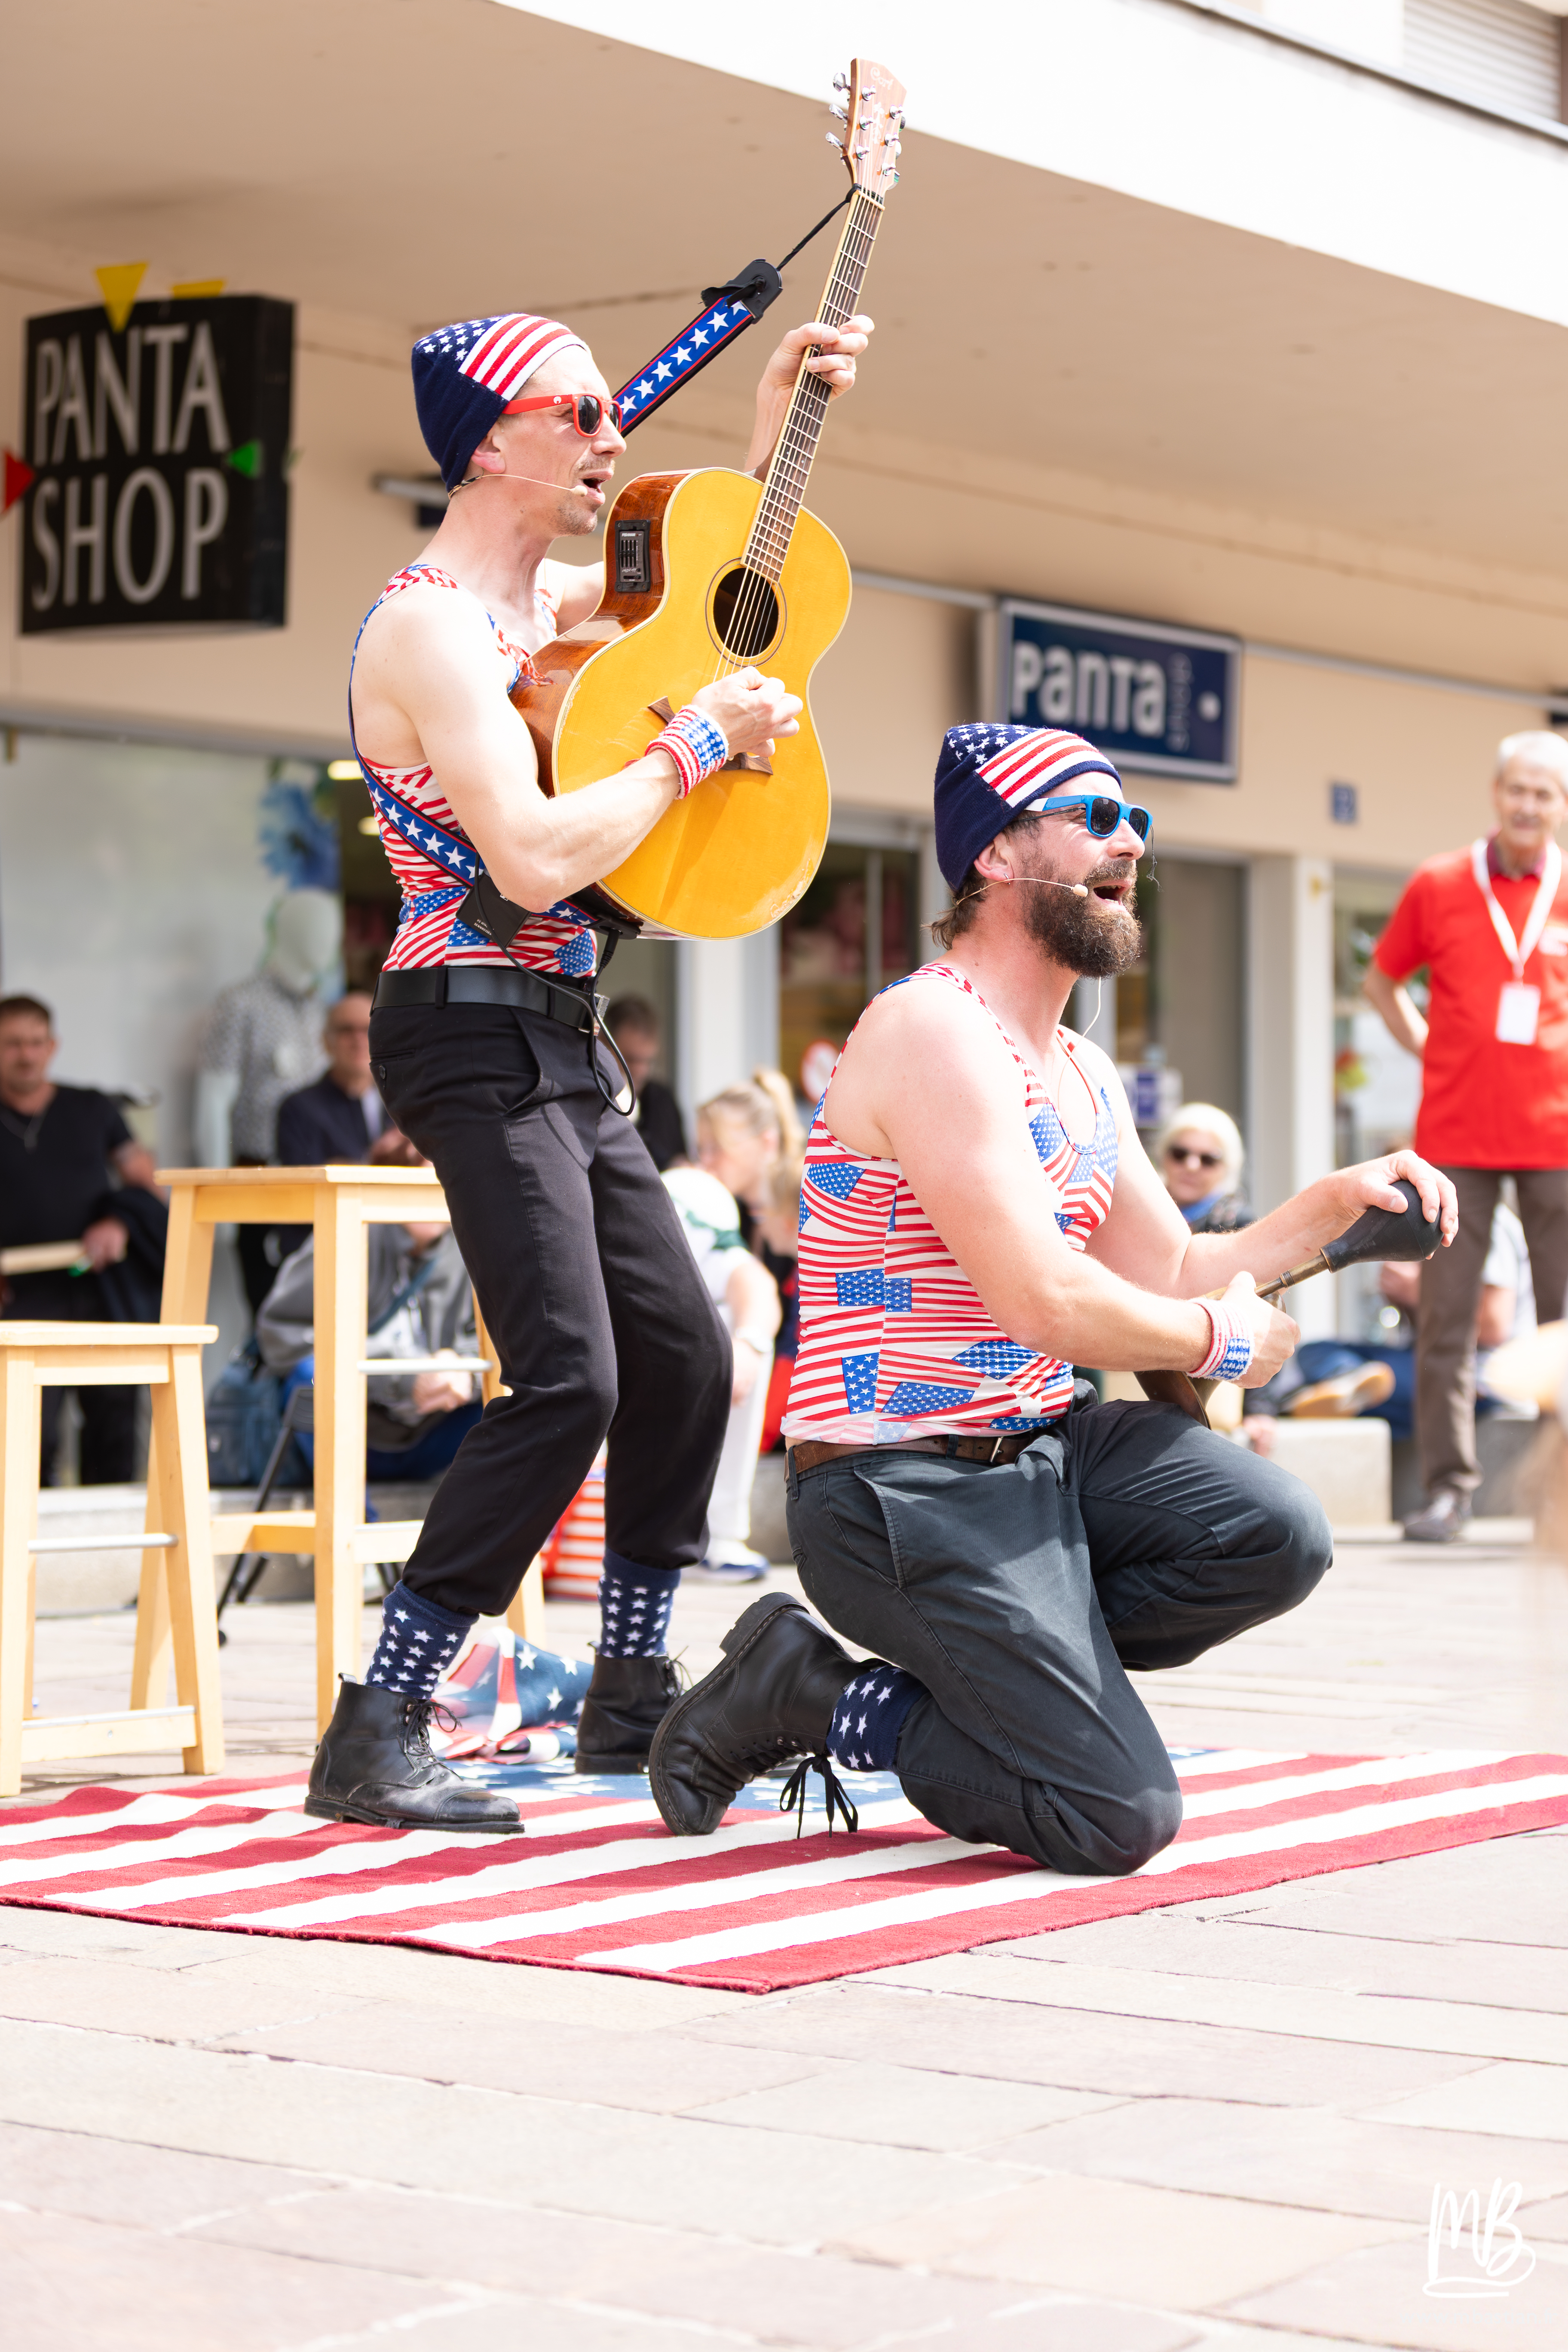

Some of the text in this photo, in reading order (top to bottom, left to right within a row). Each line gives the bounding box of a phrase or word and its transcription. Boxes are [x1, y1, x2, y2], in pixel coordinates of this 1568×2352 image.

[870, 67, 894, 90] Cort
[34, 322, 230, 465] PANTA
[32, 468, 229, 610] SHOP
